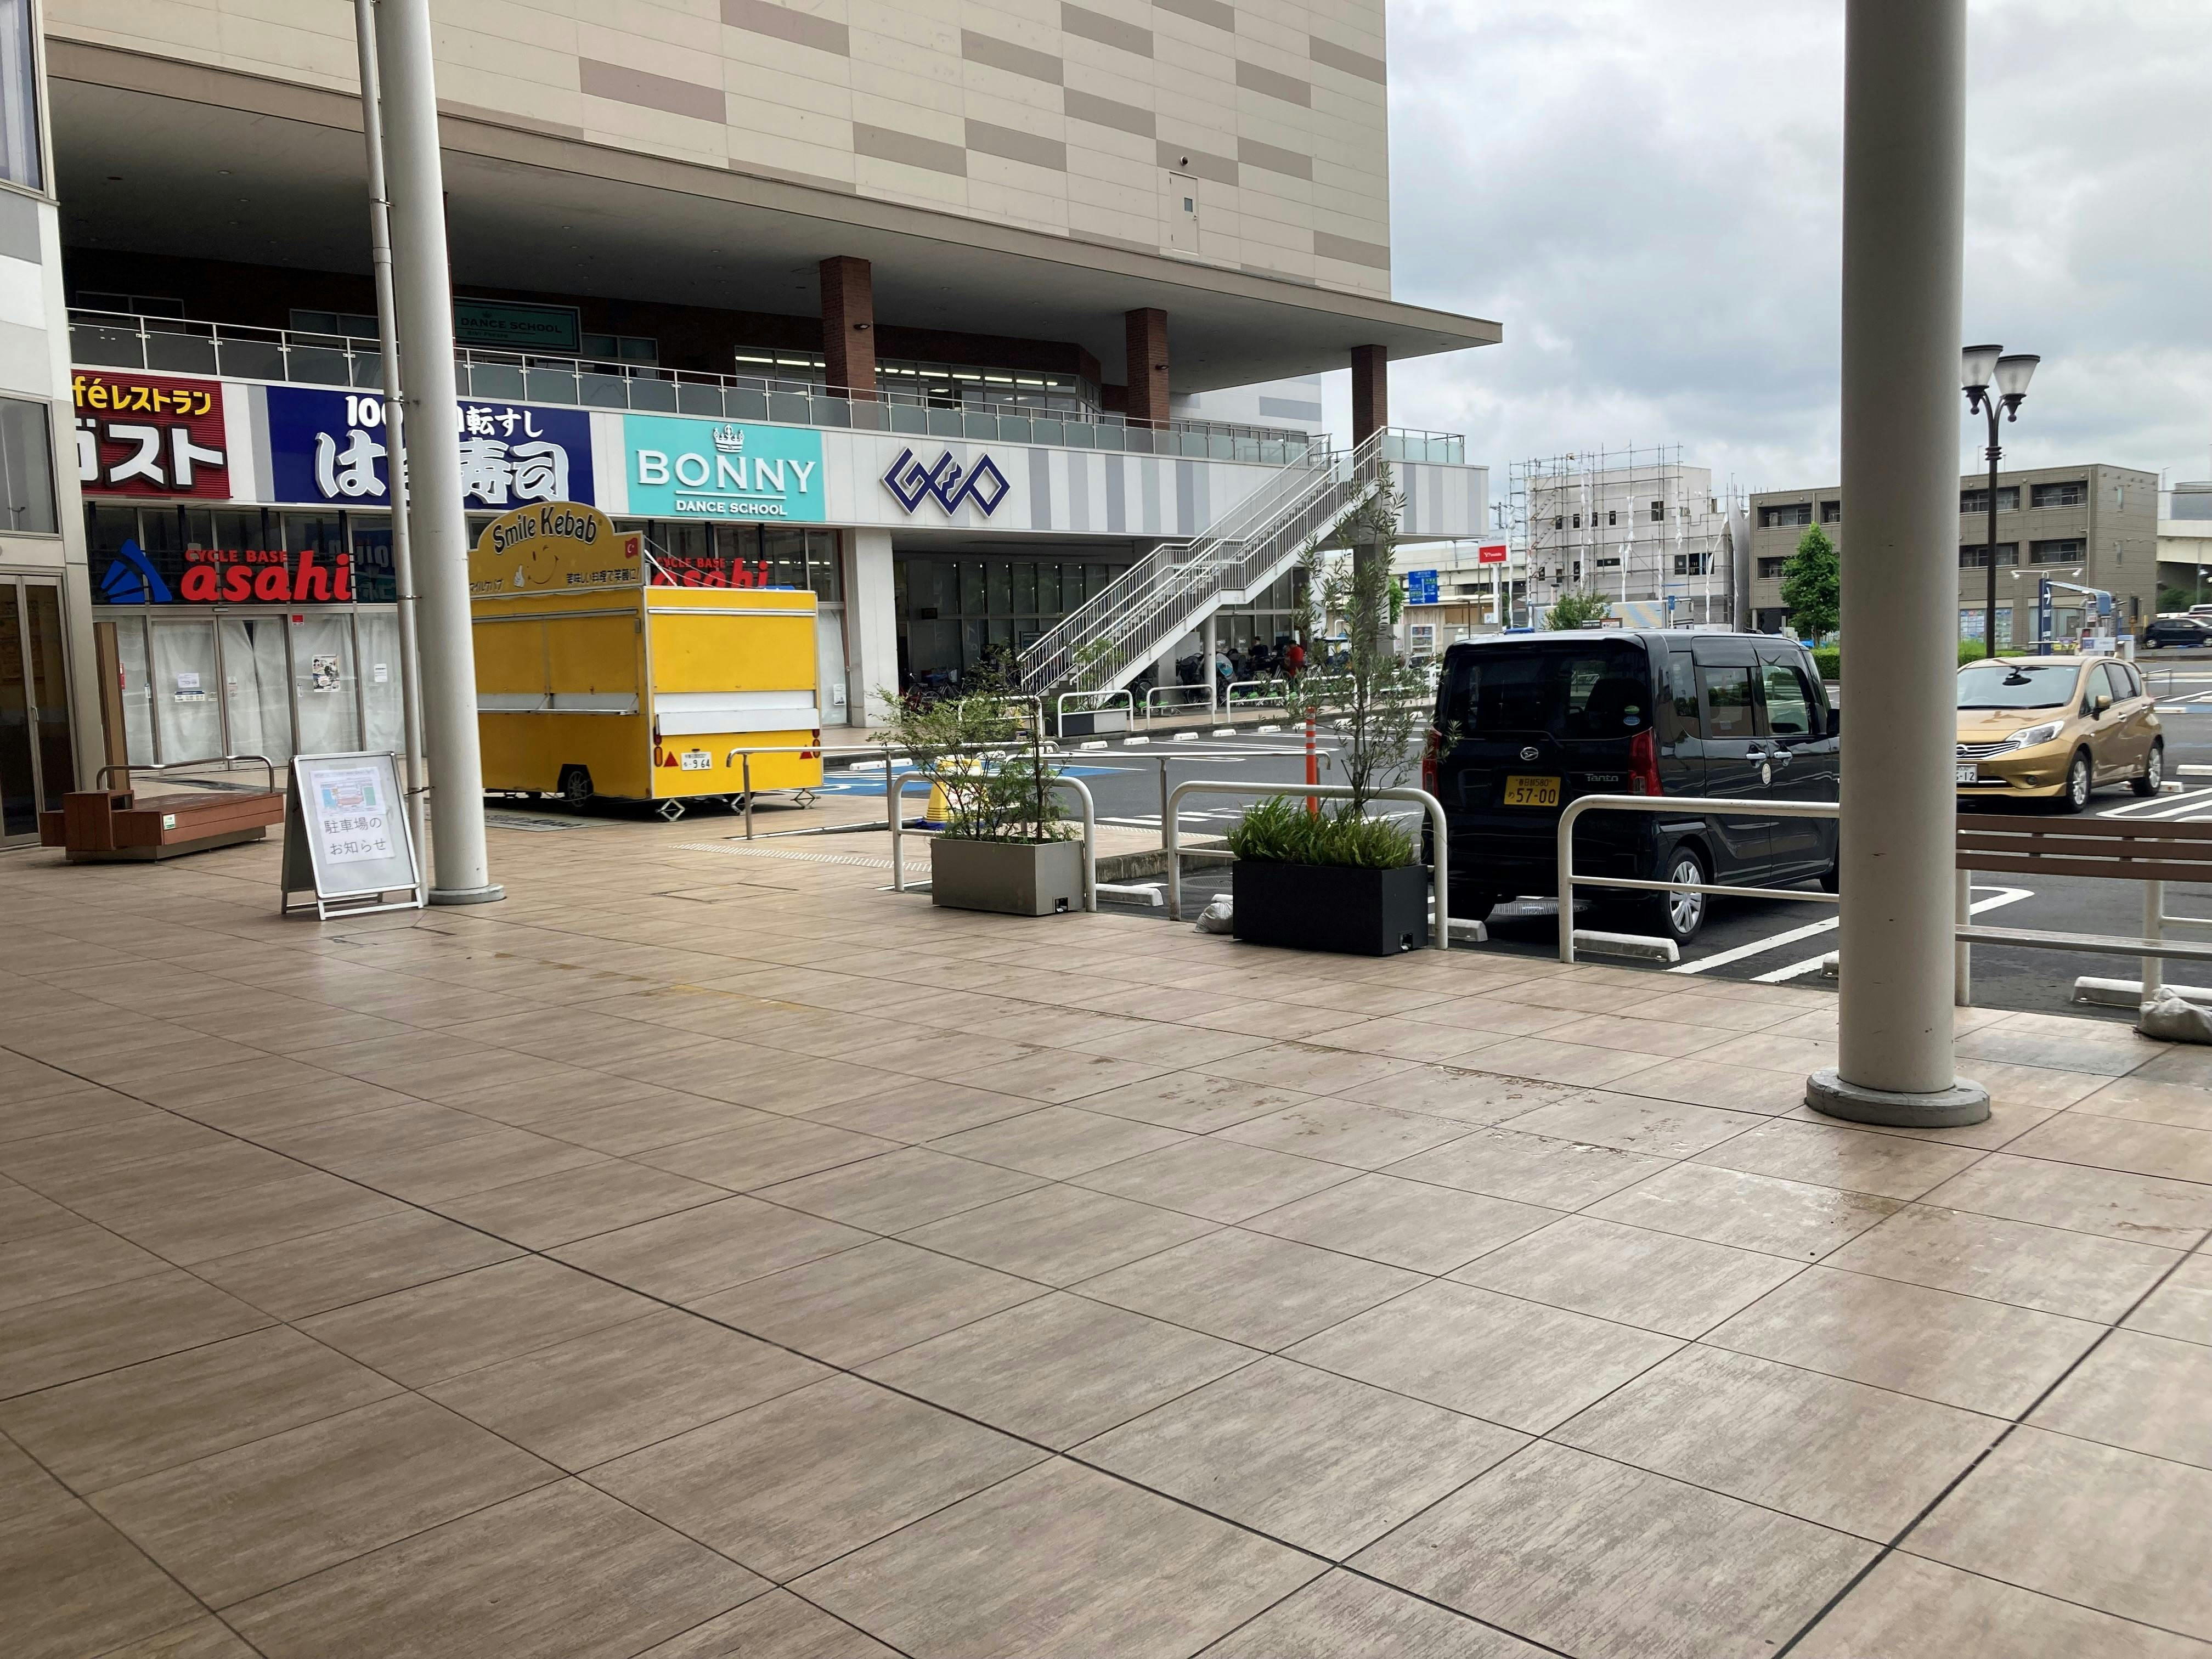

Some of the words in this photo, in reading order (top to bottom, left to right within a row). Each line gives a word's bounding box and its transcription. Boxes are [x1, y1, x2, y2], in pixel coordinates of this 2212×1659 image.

[461, 317, 506, 329] DANCE
[510, 321, 562, 334] SCHOOL
[345, 396, 544, 437] 10転すし
[636, 449, 816, 493] BONNY
[881, 447, 1011, 518] GEO
[675, 500, 726, 513] DANCE
[729, 503, 788, 516] SCHOOL
[493, 513, 537, 555] Smile
[540, 505, 597, 545] Kebab
[185, 549, 238, 562] CYCLE
[246, 550, 288, 563] BASE
[657, 557, 691, 568] CYCLE
[696, 557, 726, 568] BASE
[180, 550, 352, 601] asahi
[1584, 773, 1618, 782] Tanto
[1516, 788, 1556, 804] 57-00
[324, 817, 382, 834] 駐車場の
[330, 838, 386, 855] お知らせ
